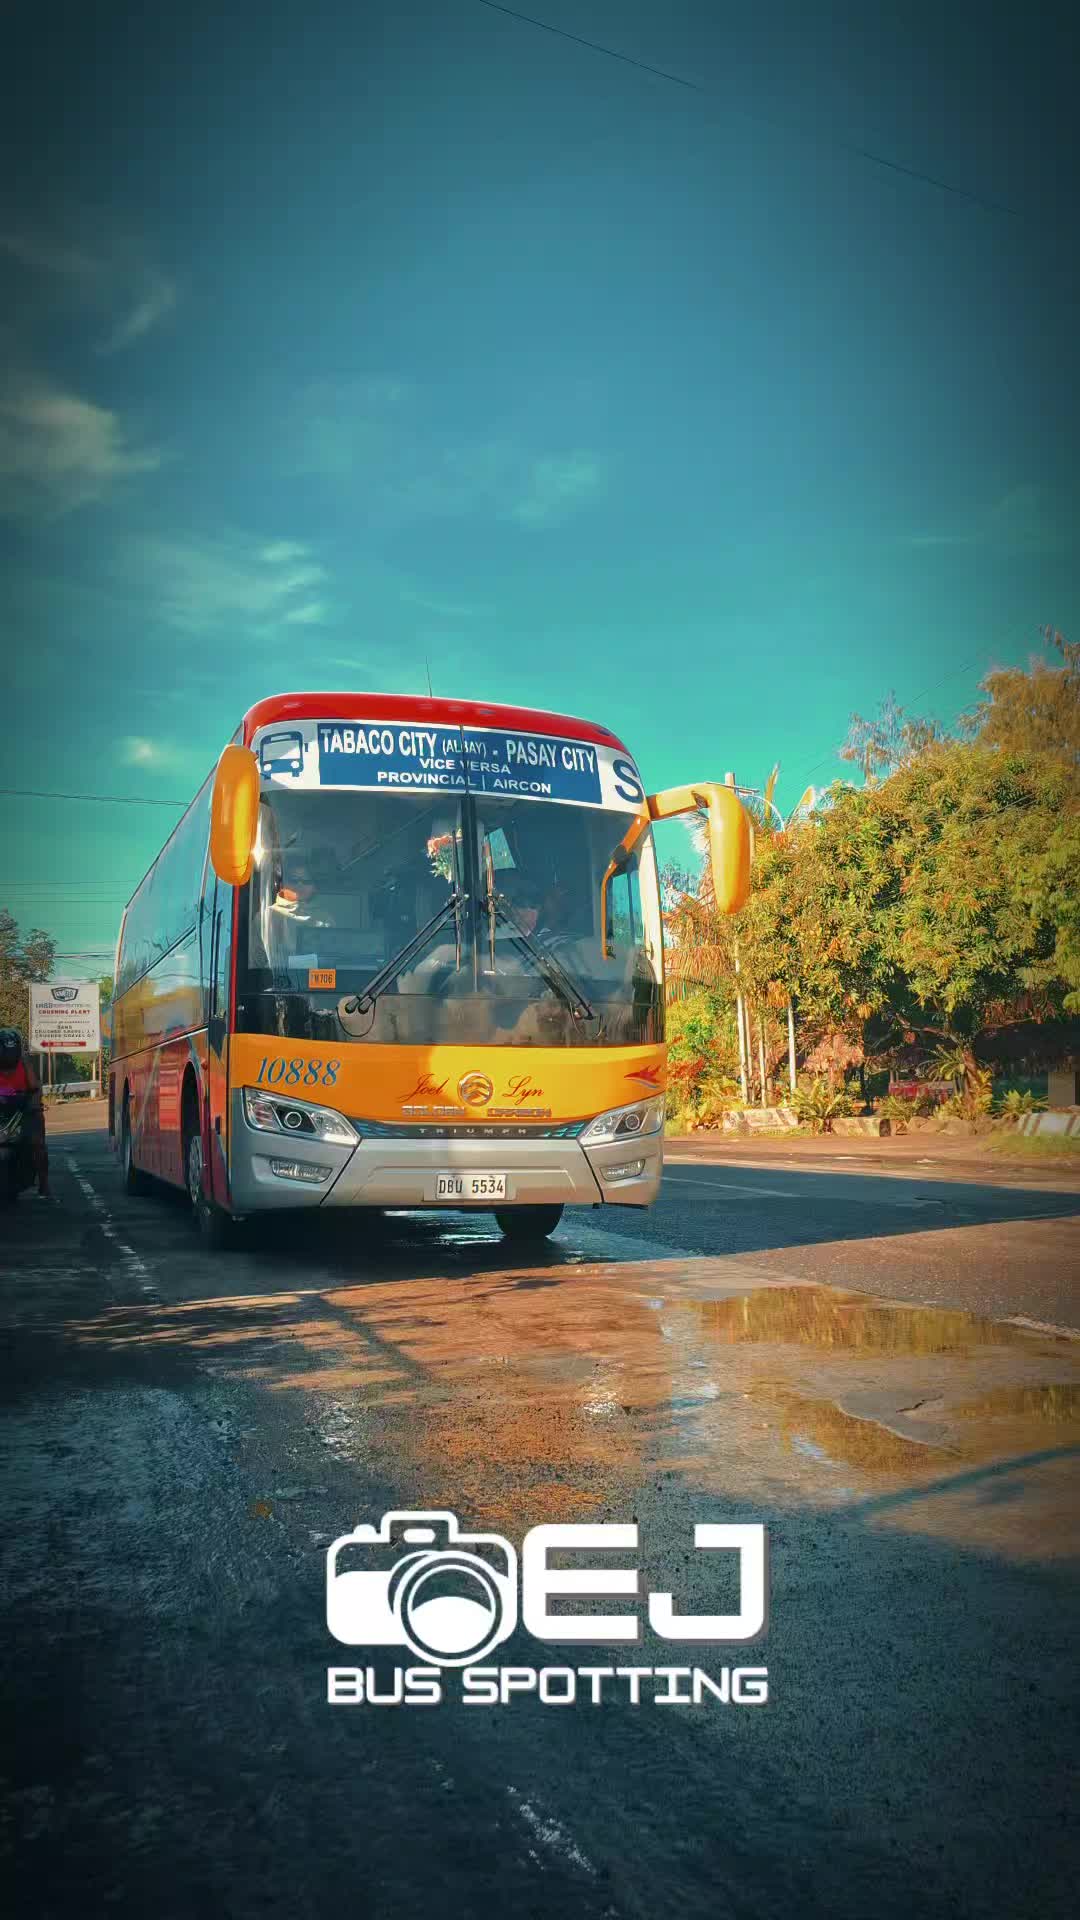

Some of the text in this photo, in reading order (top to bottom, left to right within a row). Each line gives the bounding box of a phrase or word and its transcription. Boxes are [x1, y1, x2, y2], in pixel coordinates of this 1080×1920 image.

[320, 727, 395, 755] TABACO
[398, 730, 437, 758] CITY
[506, 739, 558, 768] PASAY
[561, 746, 595, 774] CITY
[419, 758, 511, 775] VICE VERSA
[377, 771, 477, 786] PROVINCIAL
[493, 780, 552, 794] AIRCON
[256, 1056, 342, 1087] 10888
[398, 1073, 545, 1106] Joel Lyn
[418, 1127, 528, 1135] TRIUMPH
[438, 1179, 504, 1194] DBU 5534
